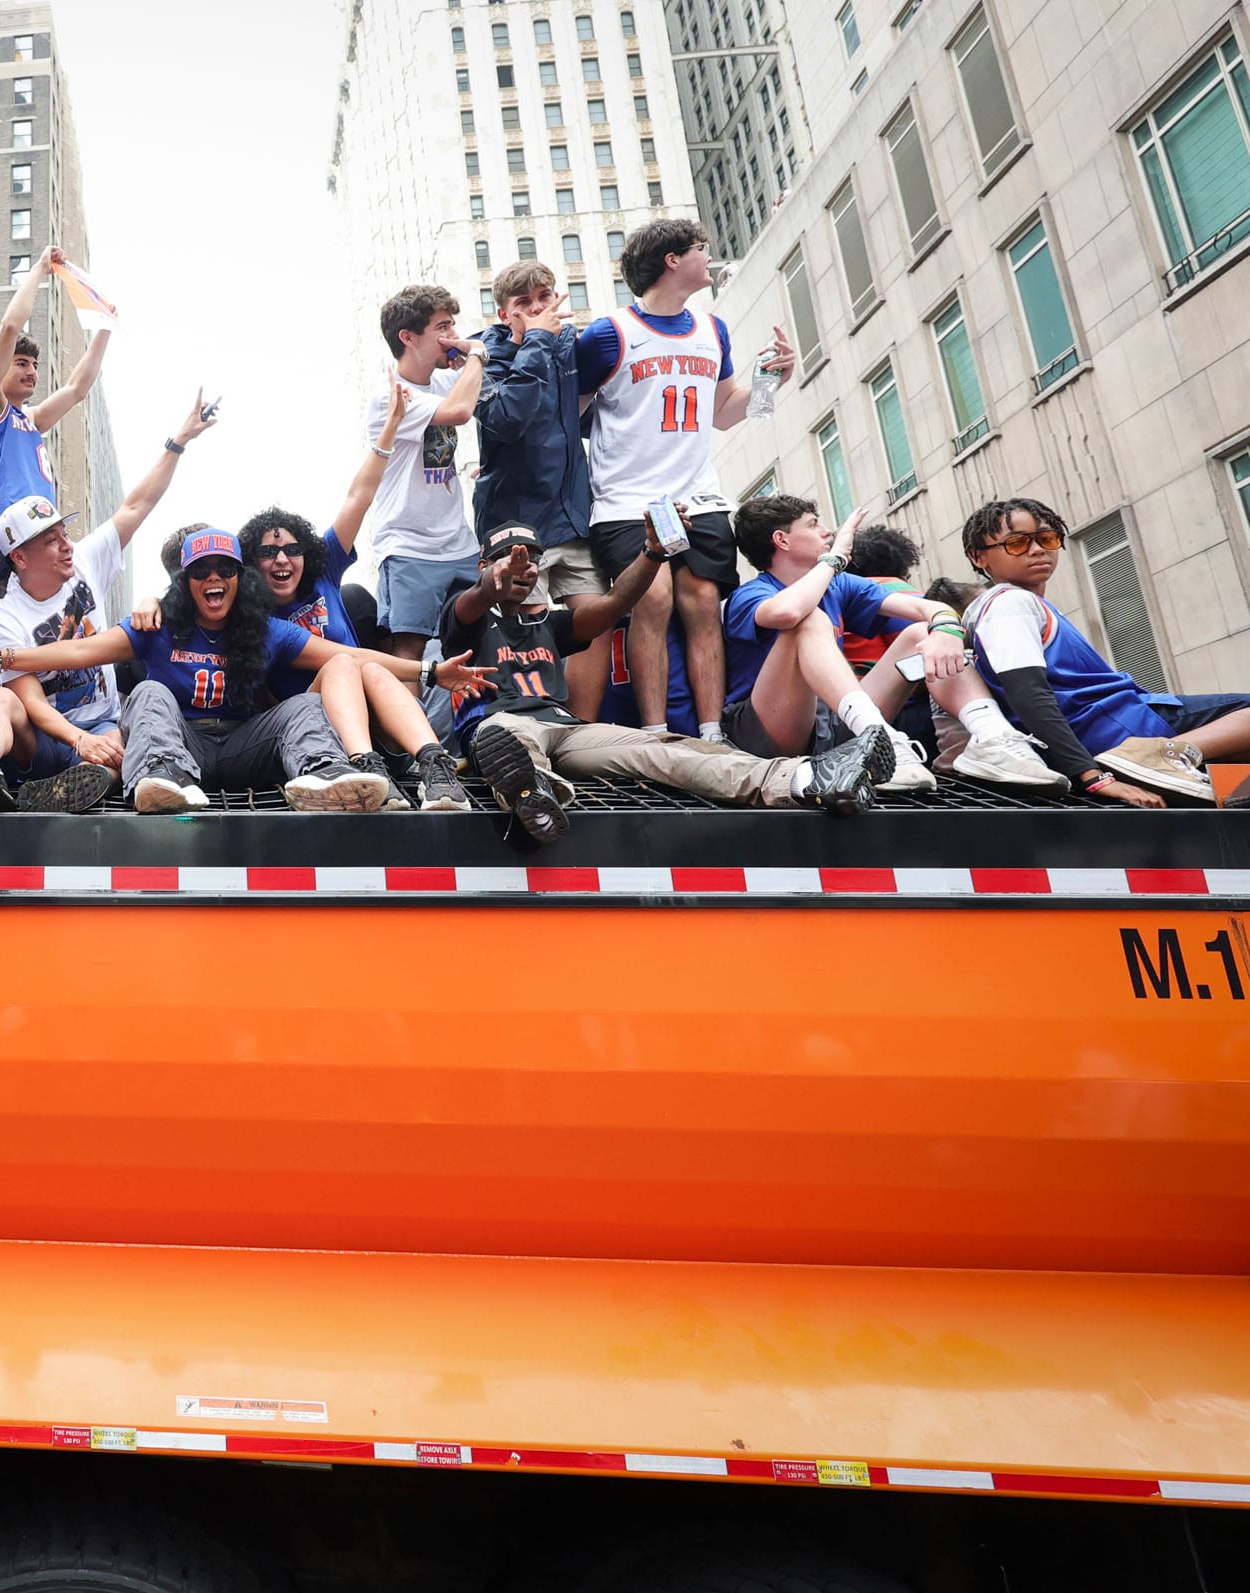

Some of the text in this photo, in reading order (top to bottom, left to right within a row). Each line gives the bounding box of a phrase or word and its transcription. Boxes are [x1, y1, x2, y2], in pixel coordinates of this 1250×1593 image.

[630, 355, 718, 384] NEW YORK
[661, 385, 699, 432] 11
[191, 535, 234, 553] NEW YORK
[191, 669, 226, 709] 11
[512, 671, 551, 697] 11
[444, 1446, 457, 1454] AXLE
[819, 1464, 866, 1473] WHEEL TORQUE
